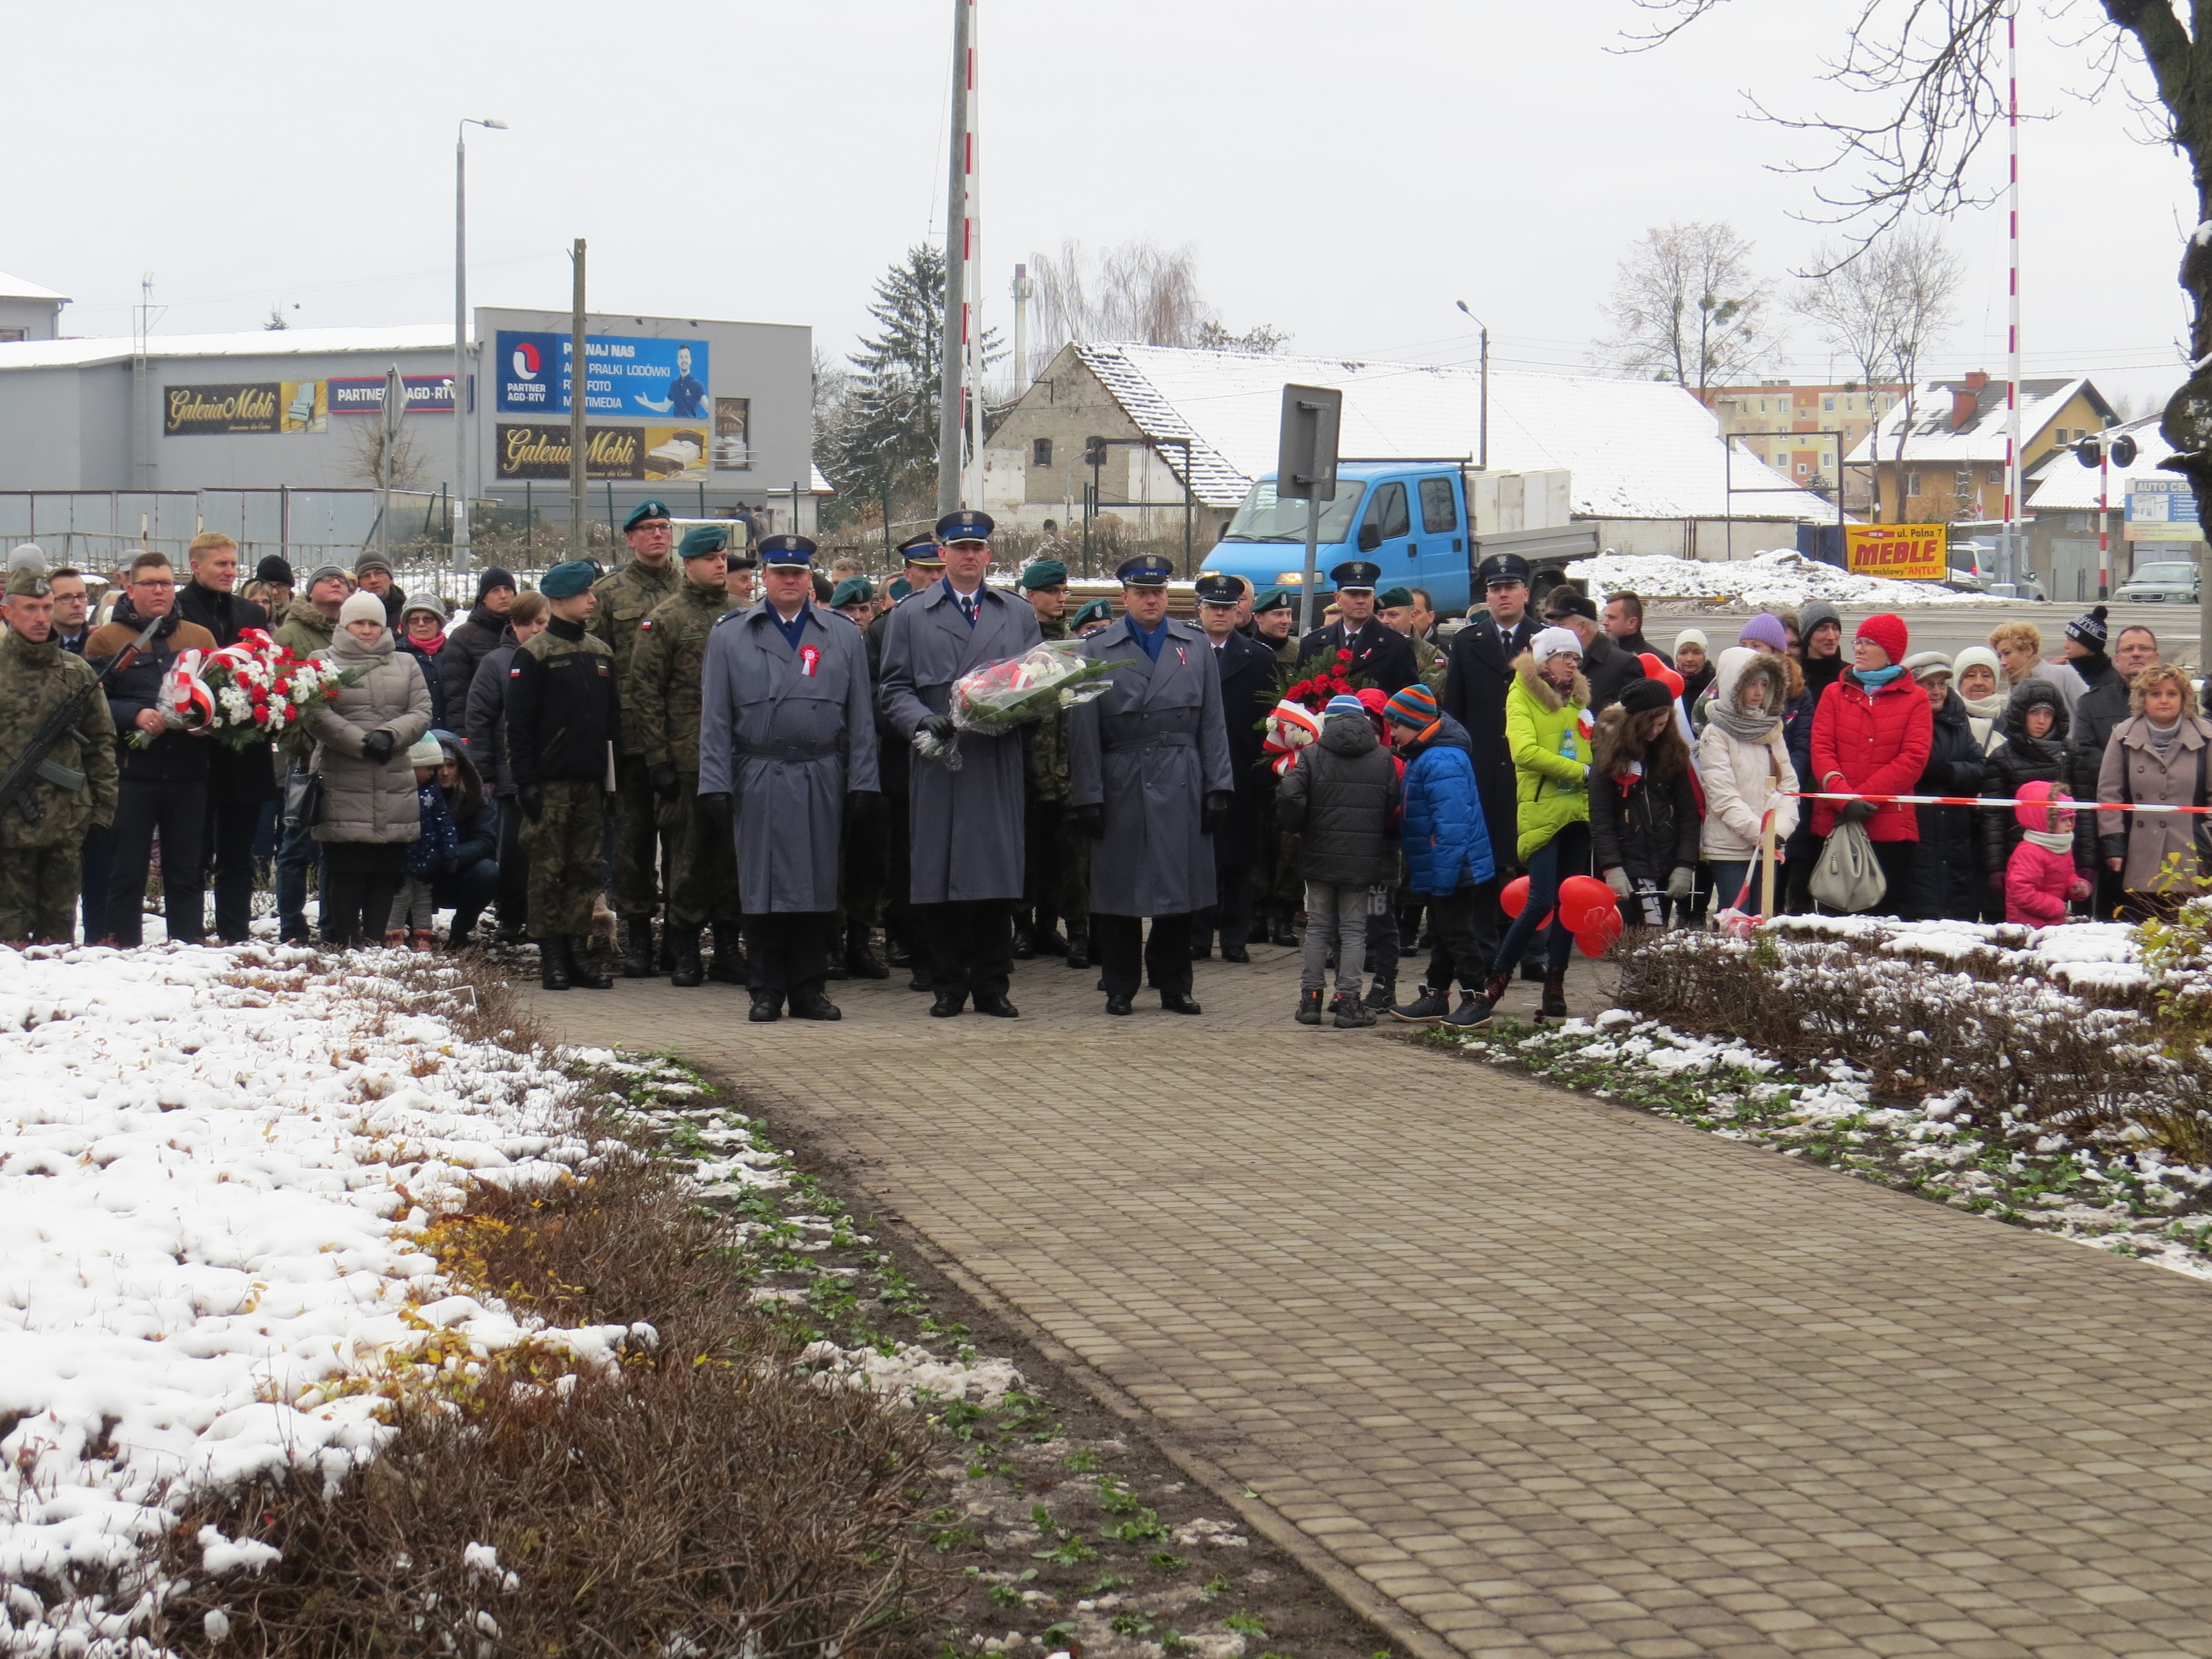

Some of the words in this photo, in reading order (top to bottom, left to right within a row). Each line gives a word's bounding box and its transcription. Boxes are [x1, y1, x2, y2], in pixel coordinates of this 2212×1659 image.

[563, 342, 609, 357] PNAJ
[611, 345, 635, 357] NAS
[589, 364, 622, 375] PRALKI
[627, 364, 670, 377] LODÓWKI
[507, 383, 546, 393] PARTNER
[587, 380, 611, 391] FOTO
[338, 388, 386, 401] PARTNE
[563, 396, 623, 408] MTIMEDIA
[168, 390, 224, 430] Galeria
[223, 388, 275, 419] Mebli
[503, 429, 572, 474] Galeria
[585, 431, 636, 465] Mebli
[2136, 482, 2166, 491] AUTO
[2171, 482, 2193, 491] CEN
[1897, 529, 1908, 537] ul.
[1911, 529, 1934, 537] Polna
[1938, 528, 1942, 536] 7
[1855, 540, 1938, 565] MEBLE
